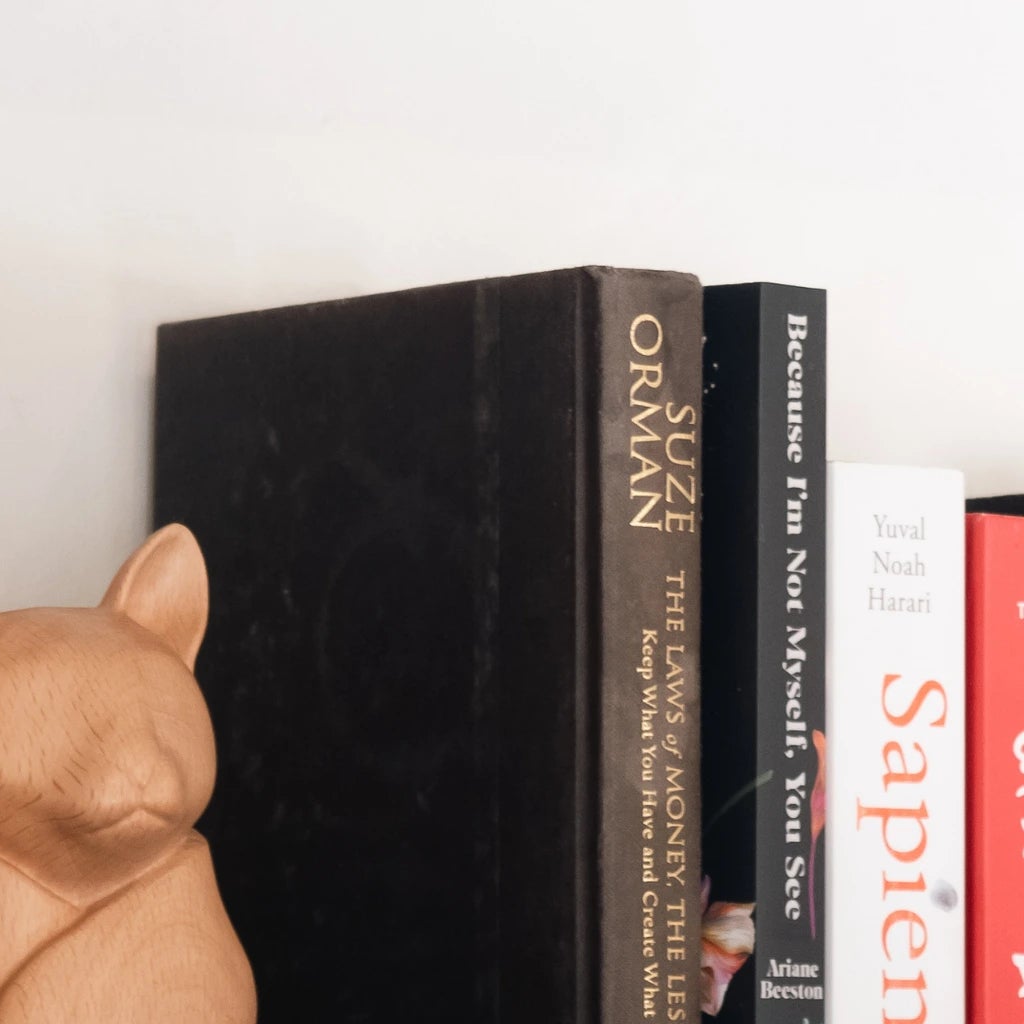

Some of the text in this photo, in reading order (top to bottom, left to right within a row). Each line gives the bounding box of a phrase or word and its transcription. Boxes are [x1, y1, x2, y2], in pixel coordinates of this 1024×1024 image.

[628, 313, 664, 532] ORMAN
[664, 401, 697, 534] SUZE
[872, 514, 926, 541] Yuval
[872, 550, 926, 577] Noah
[666, 569, 687, 632] THE
[781, 313, 809, 921] Because I'm Not Myself, You See
[867, 587, 931, 614] Harari
[636, 628, 658, 680] Keep
[665, 643, 687, 724] LAWS
[640, 685, 659, 741] What
[640, 744, 659, 782] You
[660, 733, 683, 761] of
[640, 789, 659, 842] Have
[642, 846, 659, 883] and
[641, 890, 660, 957] Create
[666, 897, 687, 962] THE
[642, 962, 661, 1020] What
[761, 981, 824, 1000] Beeston
[766, 959, 819, 979] Ariane
